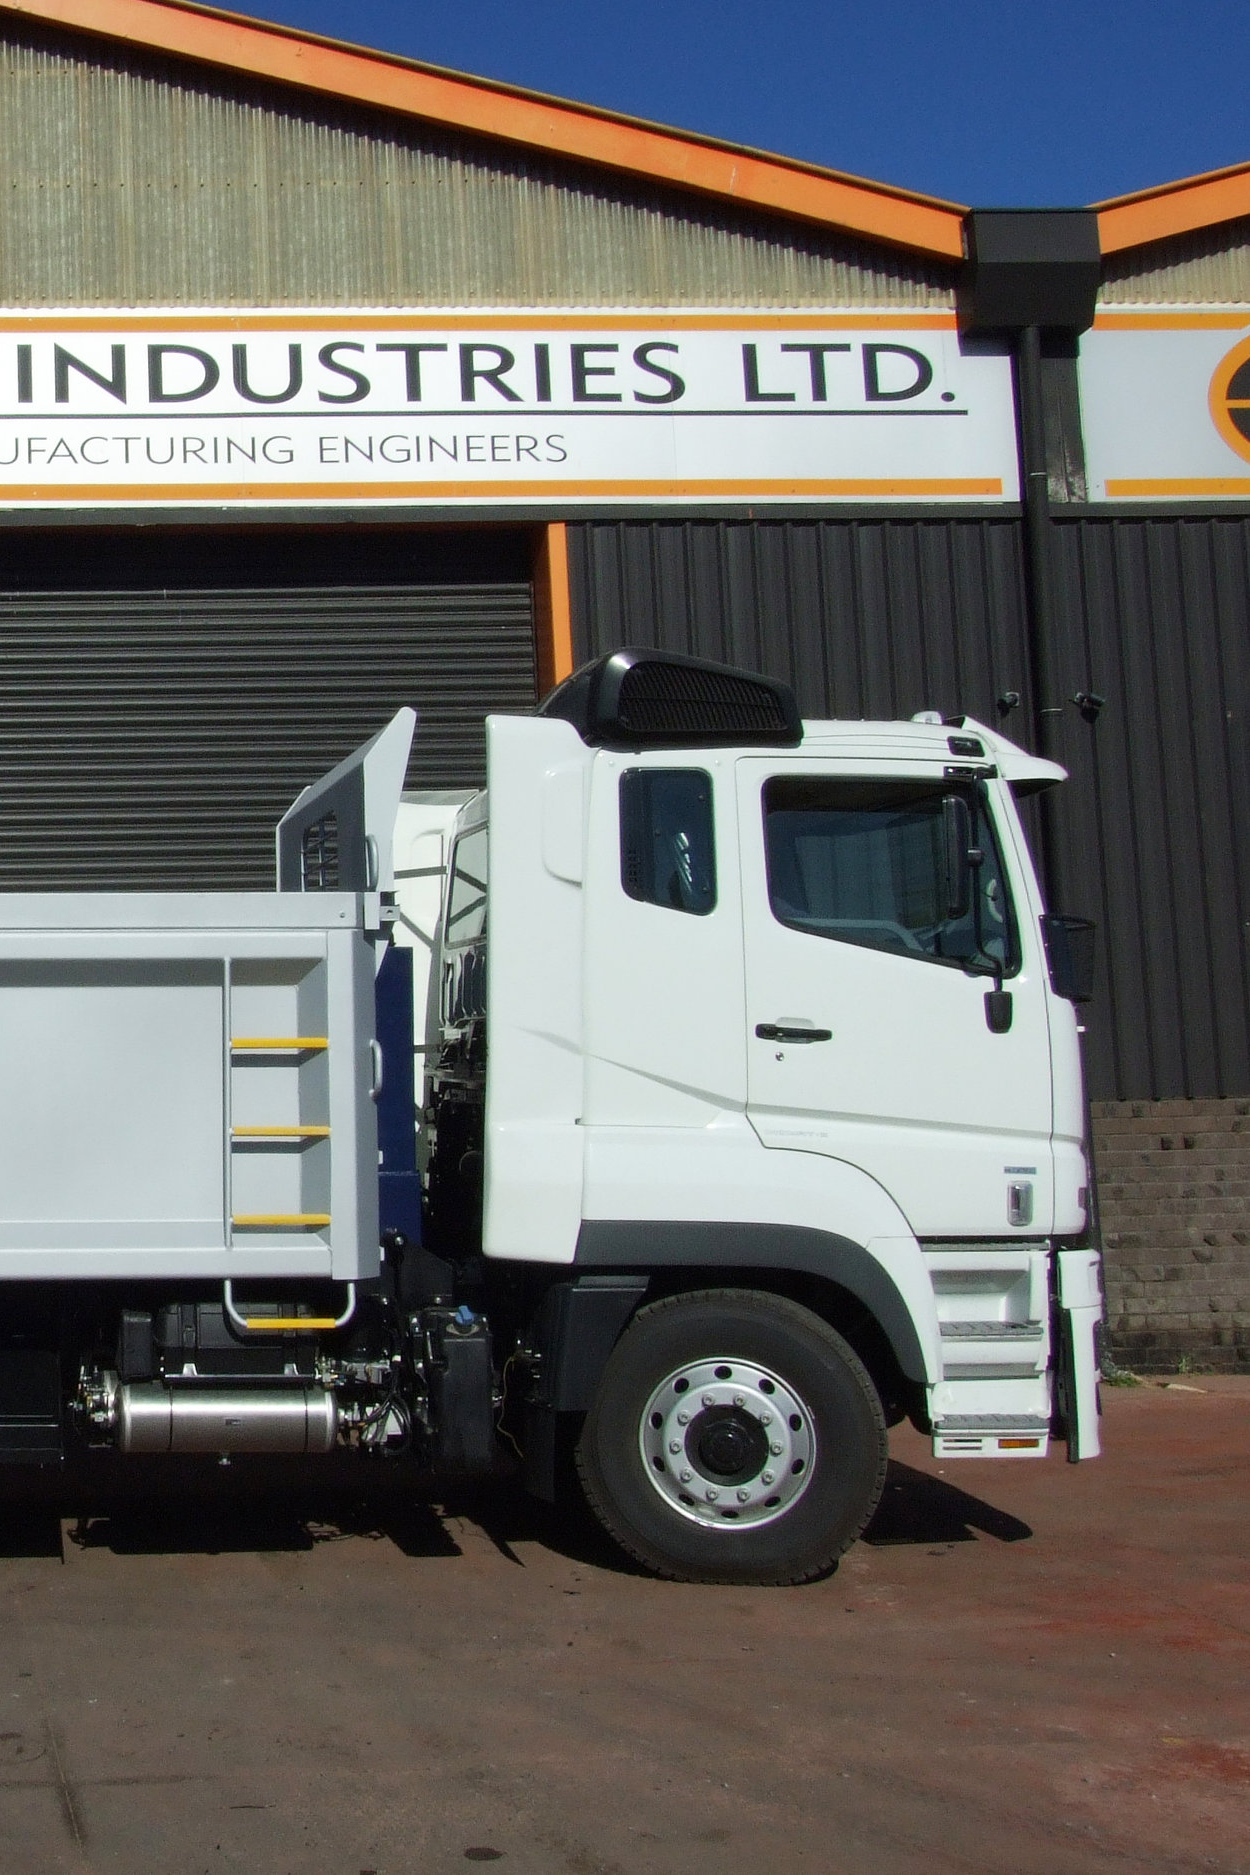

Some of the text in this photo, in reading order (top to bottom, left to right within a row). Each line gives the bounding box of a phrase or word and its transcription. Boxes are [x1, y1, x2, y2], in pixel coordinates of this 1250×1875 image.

[17, 341, 687, 405] INDUSTRIES
[742, 343, 957, 403] LTD.
[319, 435, 568, 464] ENGINEERS
